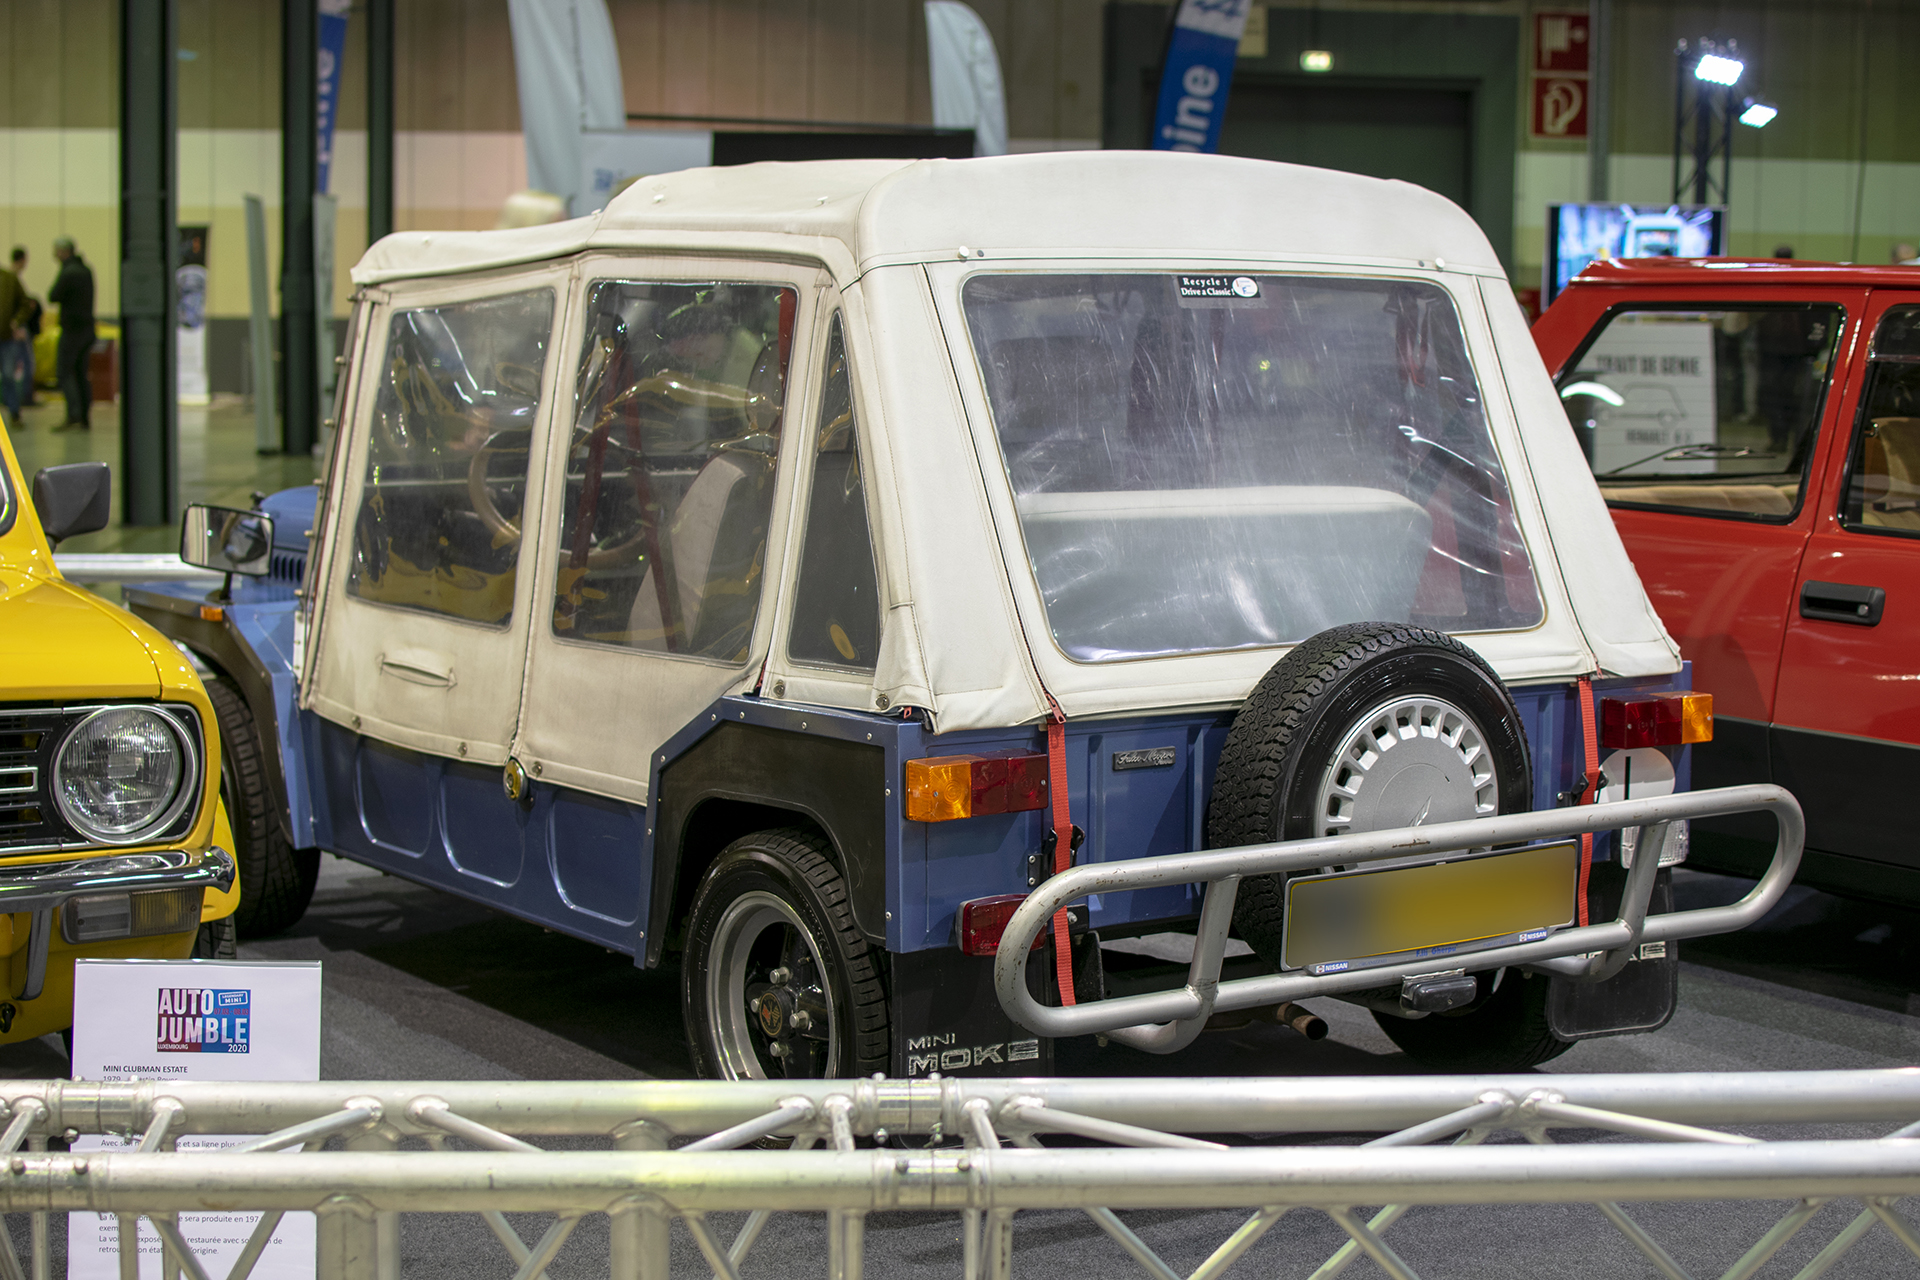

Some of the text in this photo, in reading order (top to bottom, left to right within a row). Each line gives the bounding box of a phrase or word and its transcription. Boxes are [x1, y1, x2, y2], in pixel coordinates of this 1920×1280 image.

[1161, 64, 1220, 153] ine
[1182, 277, 1220, 288] Recycle
[1180, 287, 1201, 296] Drive
[1526, 930, 1547, 940] NISSAN
[1324, 962, 1348, 972] NISSAN
[158, 989, 215, 1015] AUTO
[157, 1017, 248, 1044] JUMBLE
[908, 1033, 956, 1051] MINI
[228, 1044, 248, 1053] 2020
[908, 1039, 1039, 1076] MOKE
[122, 1065, 161, 1073] CLUBMAN
[162, 1065, 189, 1074] ESTATE
[101, 1139, 118, 1147] Avec
[182, 1140, 191, 1148] et
[201, 1139, 219, 1149] ligne
[201, 1215, 233, 1223] produite
[245, 1215, 260, 1223] 197
[187, 1236, 222, 1244] restaurée
